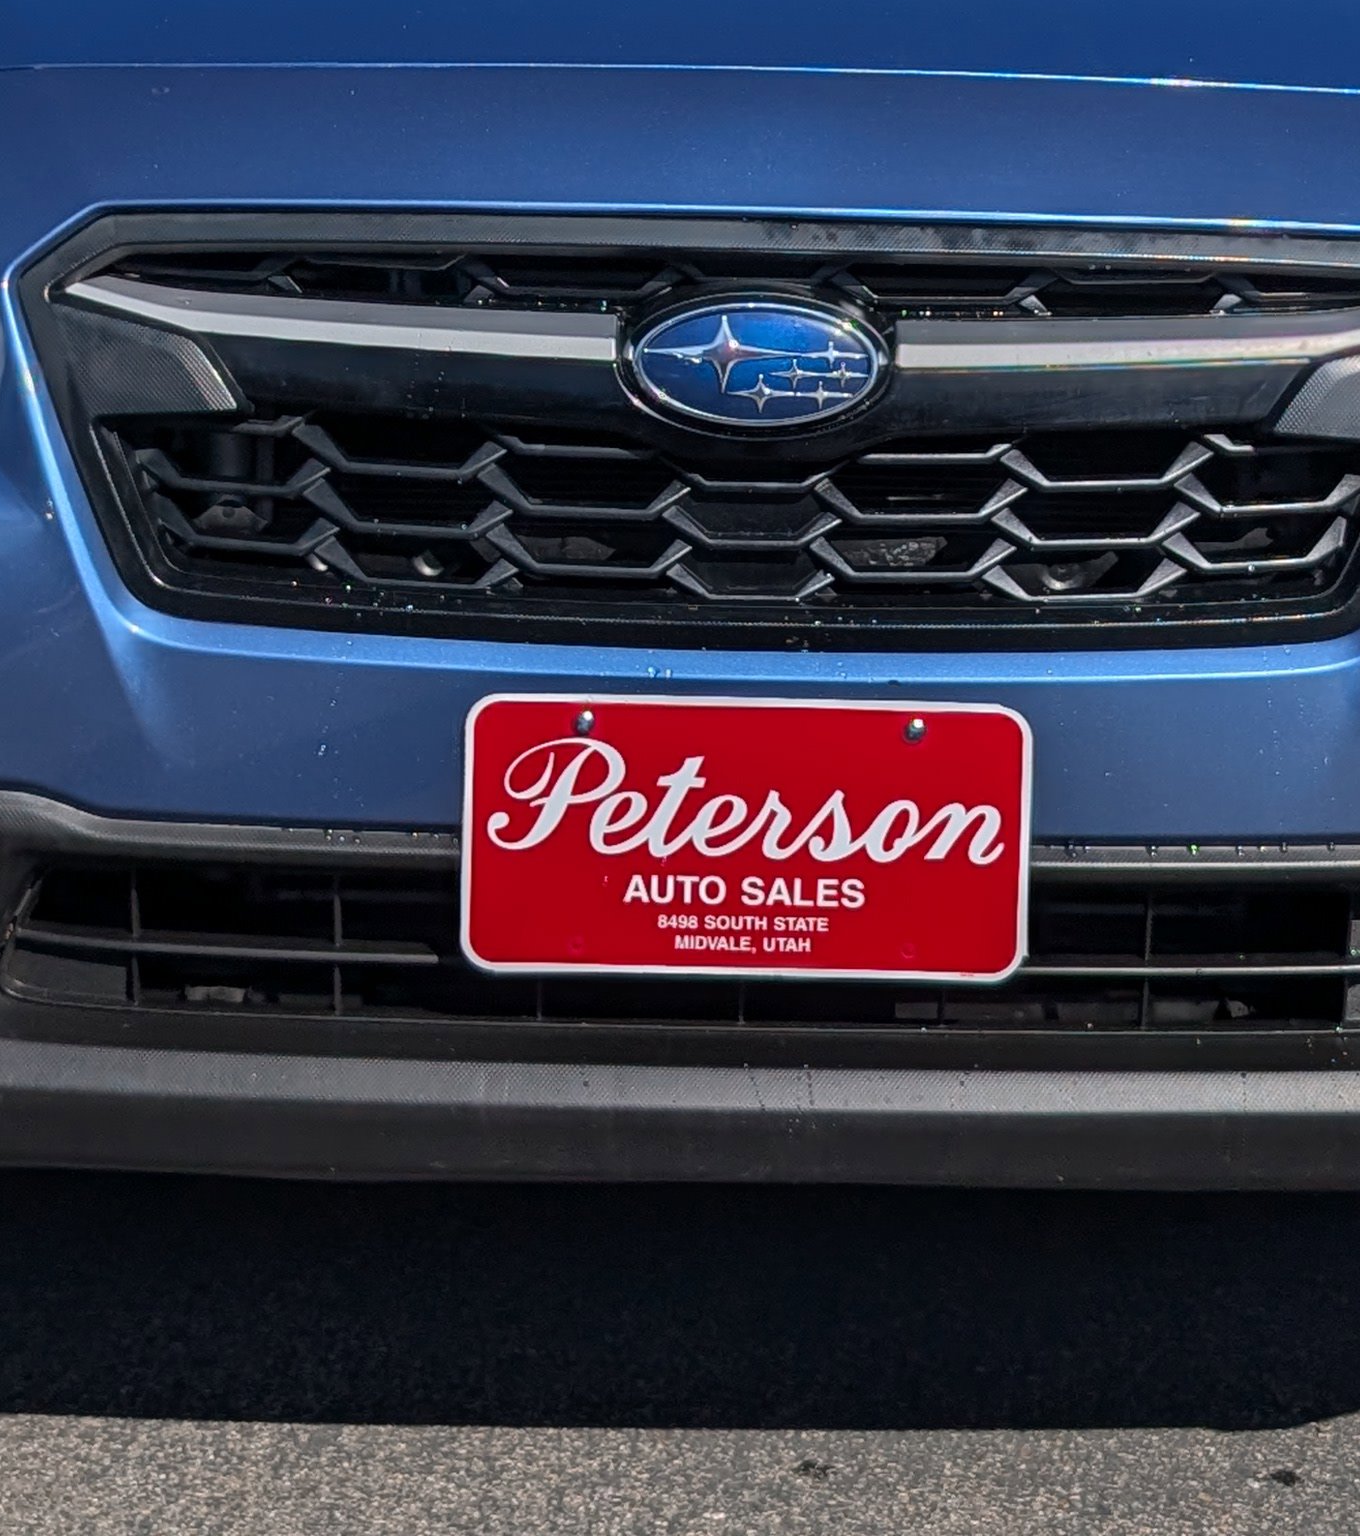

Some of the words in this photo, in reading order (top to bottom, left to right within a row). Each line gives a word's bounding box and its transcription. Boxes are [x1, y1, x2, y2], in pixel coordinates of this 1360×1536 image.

[487, 737, 1004, 865] Peterson
[623, 874, 726, 905] AUTO
[740, 876, 866, 908] SALES
[657, 914, 698, 930] 8498
[704, 914, 768, 931] SOUTH
[773, 916, 829, 932] STATE
[674, 935, 757, 954] MIDVALE,
[763, 937, 811, 953] UTAH
